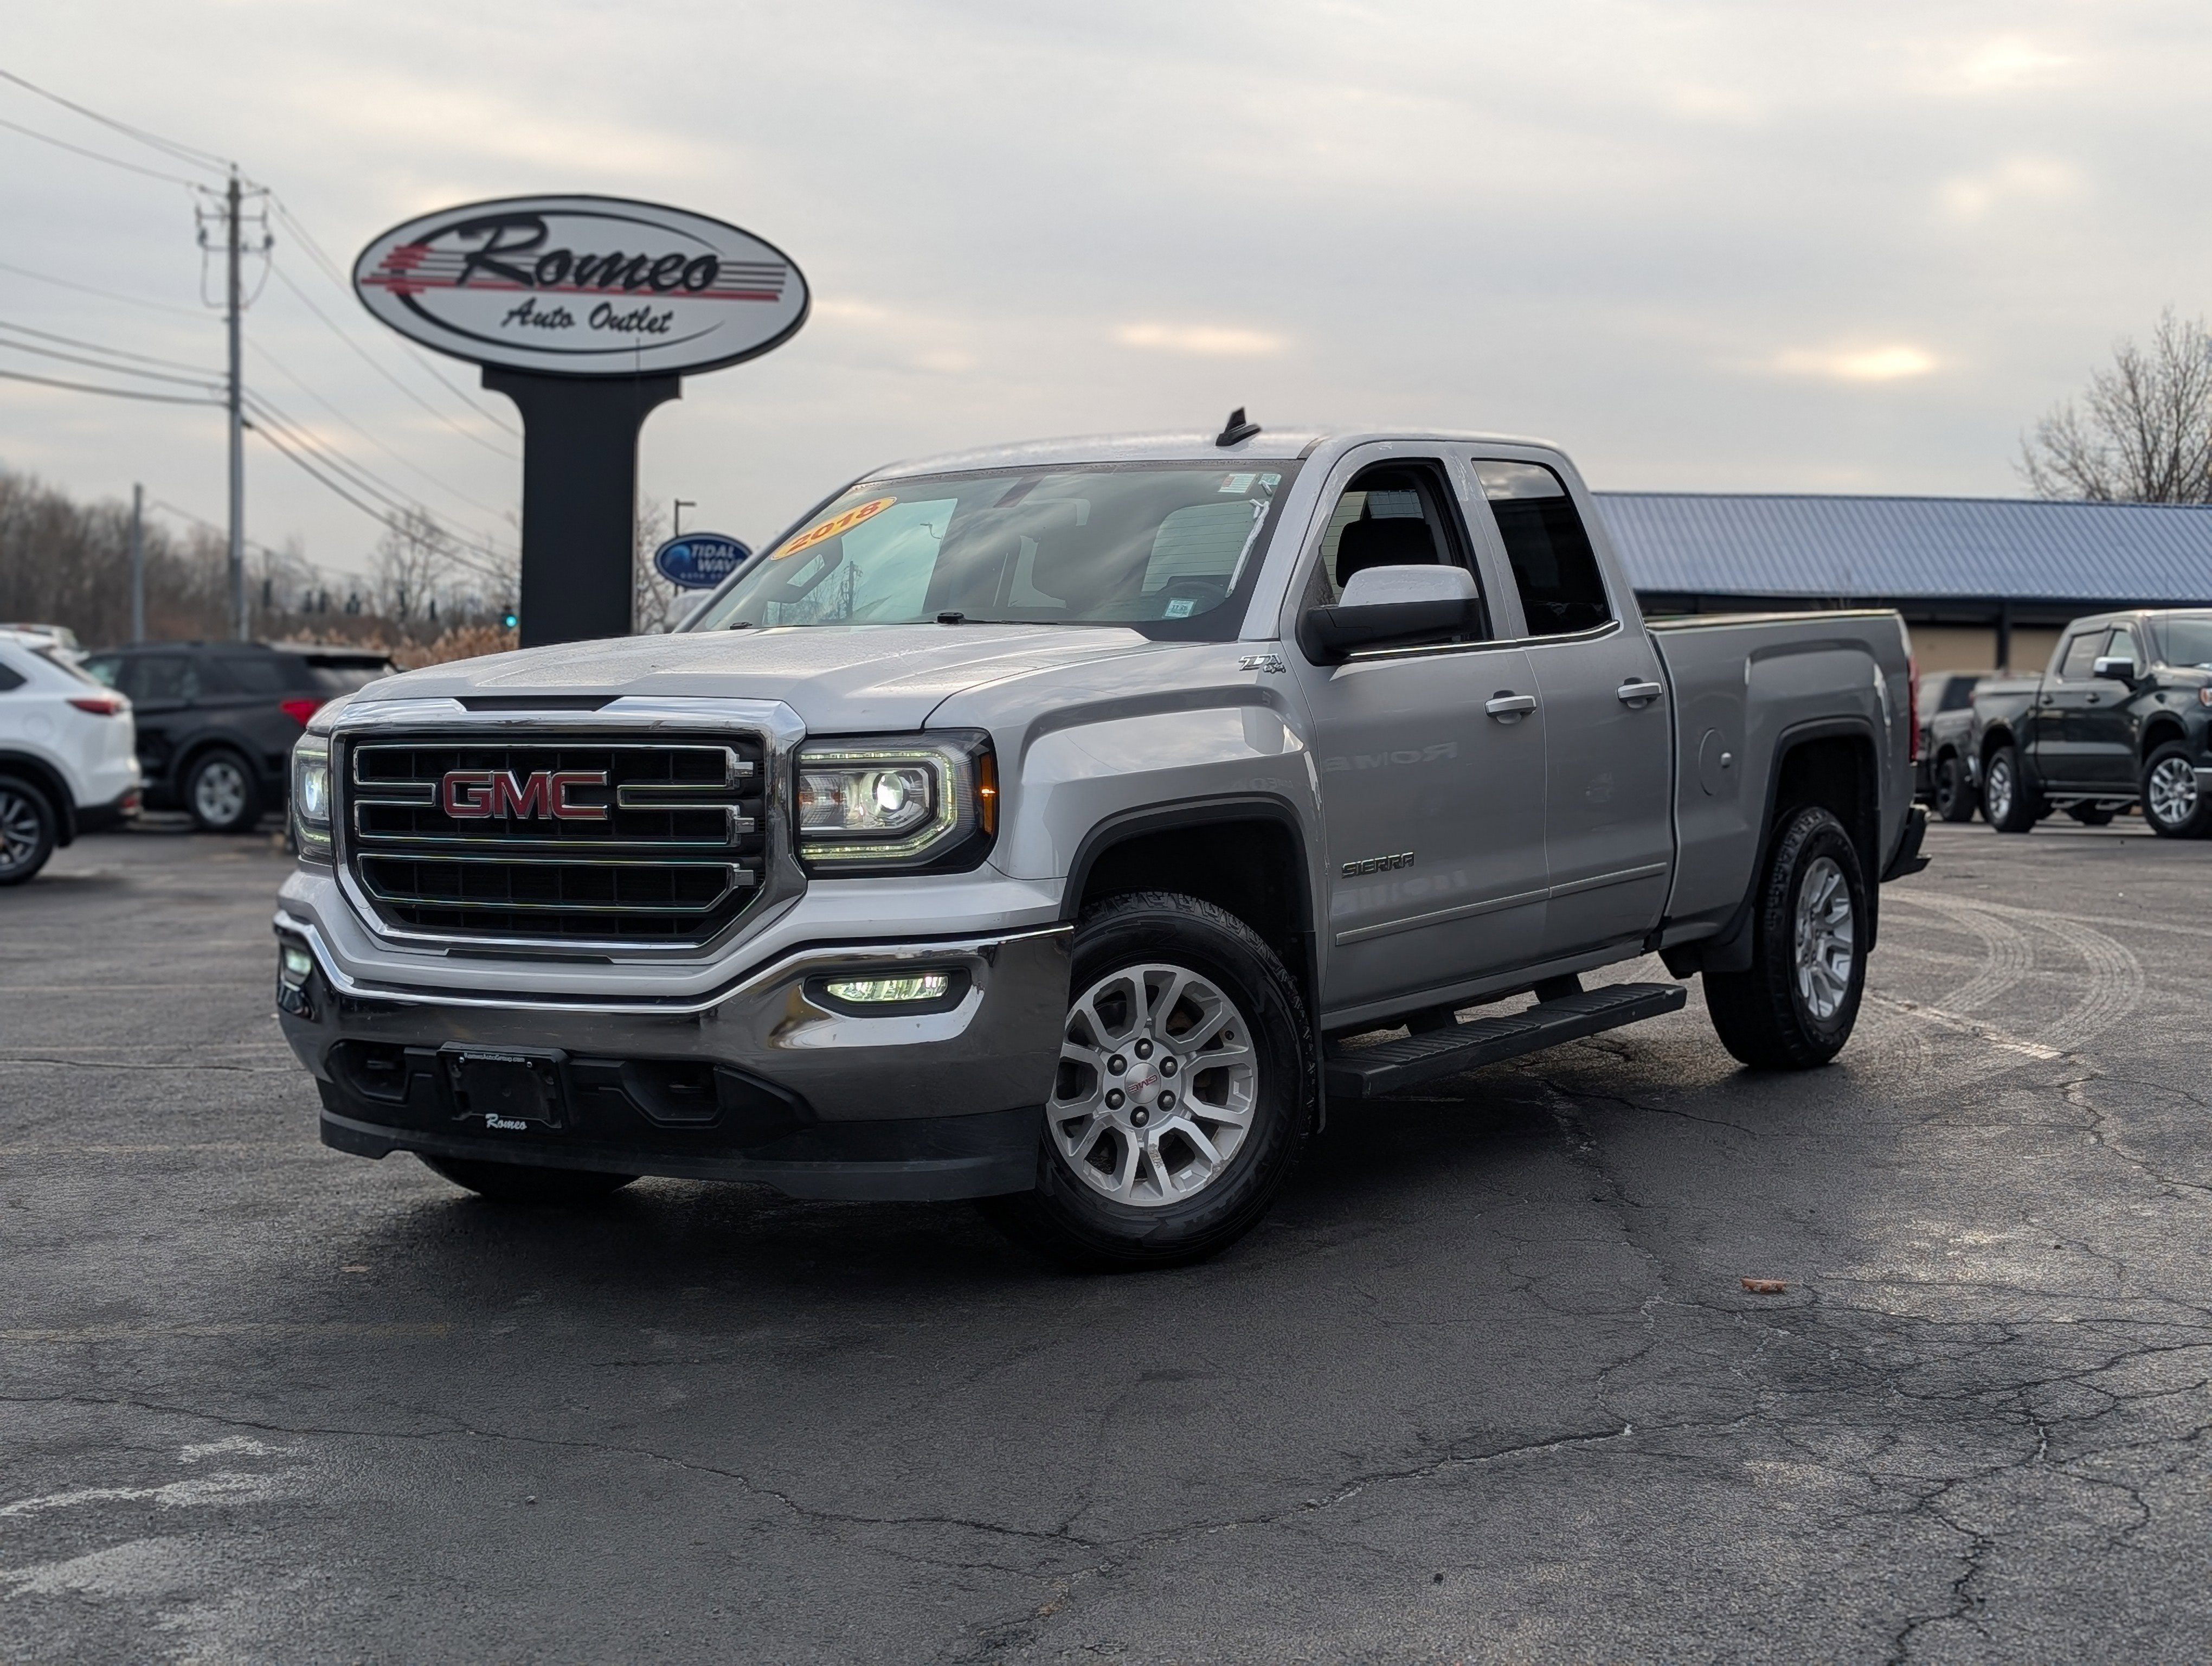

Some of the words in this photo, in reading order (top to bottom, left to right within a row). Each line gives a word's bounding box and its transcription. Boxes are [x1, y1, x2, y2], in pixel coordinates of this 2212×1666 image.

[457, 215, 720, 292] Romeo
[501, 297, 576, 330] Auto
[589, 302, 672, 335] Outlet
[786, 501, 881, 554] 2018
[691, 544, 735, 558] TIDAL
[443, 769, 611, 820] GMC
[1341, 852, 1414, 879] SIERRA
[1128, 1074, 1158, 1094] GMC
[485, 1113, 527, 1130] Romeo
